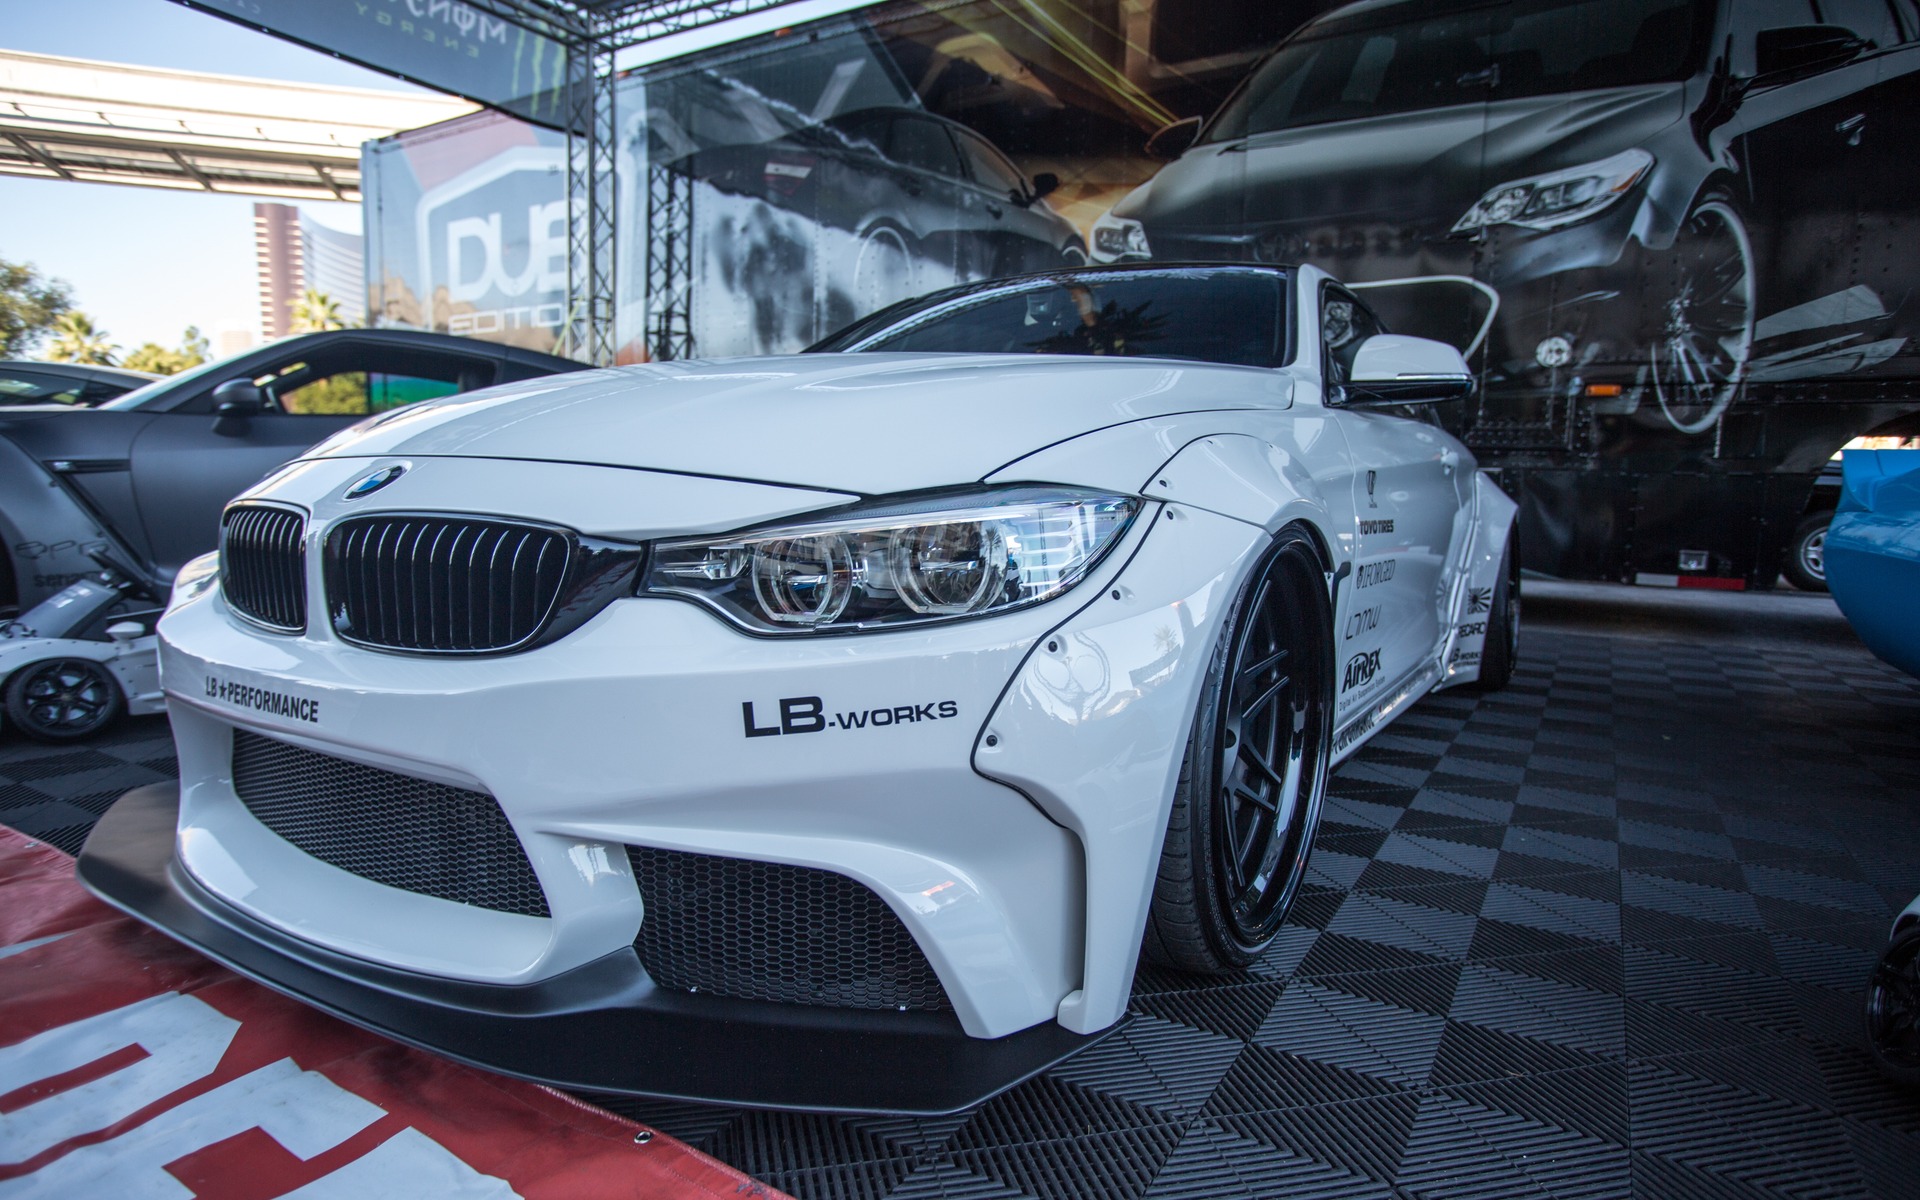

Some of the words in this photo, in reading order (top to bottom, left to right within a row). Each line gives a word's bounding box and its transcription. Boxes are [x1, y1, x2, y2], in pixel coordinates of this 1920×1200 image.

[447, 198, 590, 304] DUB
[1359, 520, 1377, 535] TOYO
[1378, 519, 1394, 533] TIRES
[227, 682, 319, 723] PERFORMANCE
[742, 695, 958, 738] LB-WORKS
